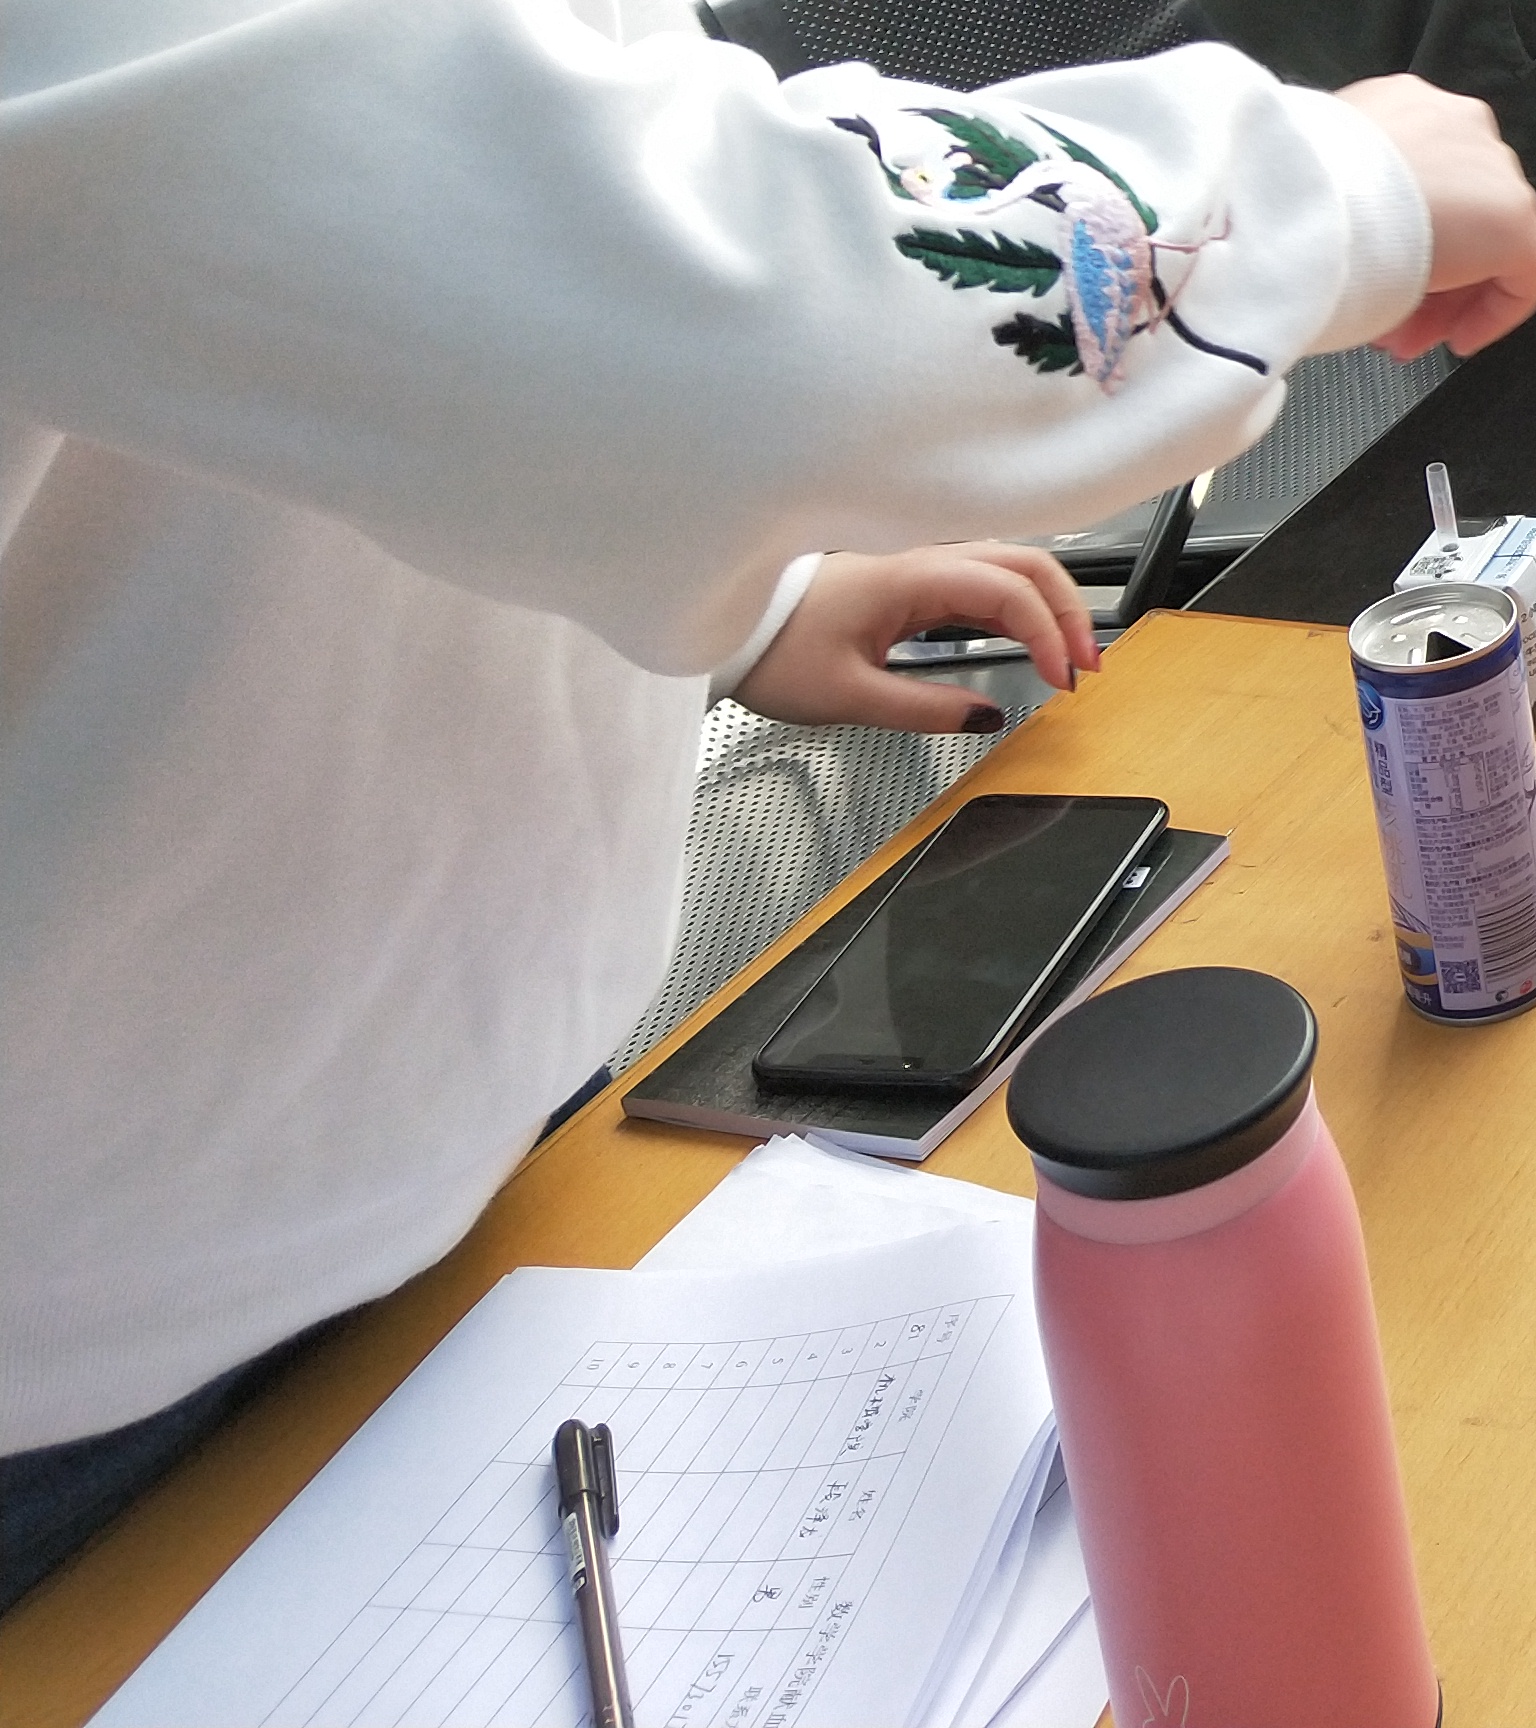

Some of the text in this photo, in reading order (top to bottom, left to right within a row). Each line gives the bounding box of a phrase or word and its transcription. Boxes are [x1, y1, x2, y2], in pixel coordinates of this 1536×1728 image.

[935, 1314, 960, 1344] 序号
[872, 1340, 886, 1349] 2
[584, 1357, 604, 1370] 10
[700, 1361, 712, 1370] 7
[734, 1360, 748, 1368] 6
[770, 1357, 783, 1365] 5
[897, 1390, 924, 1422] 学院
[848, 1490, 876, 1522] 姓名
[751, 1584, 782, 1604] 男
[796, 1576, 830, 1609] 性别
